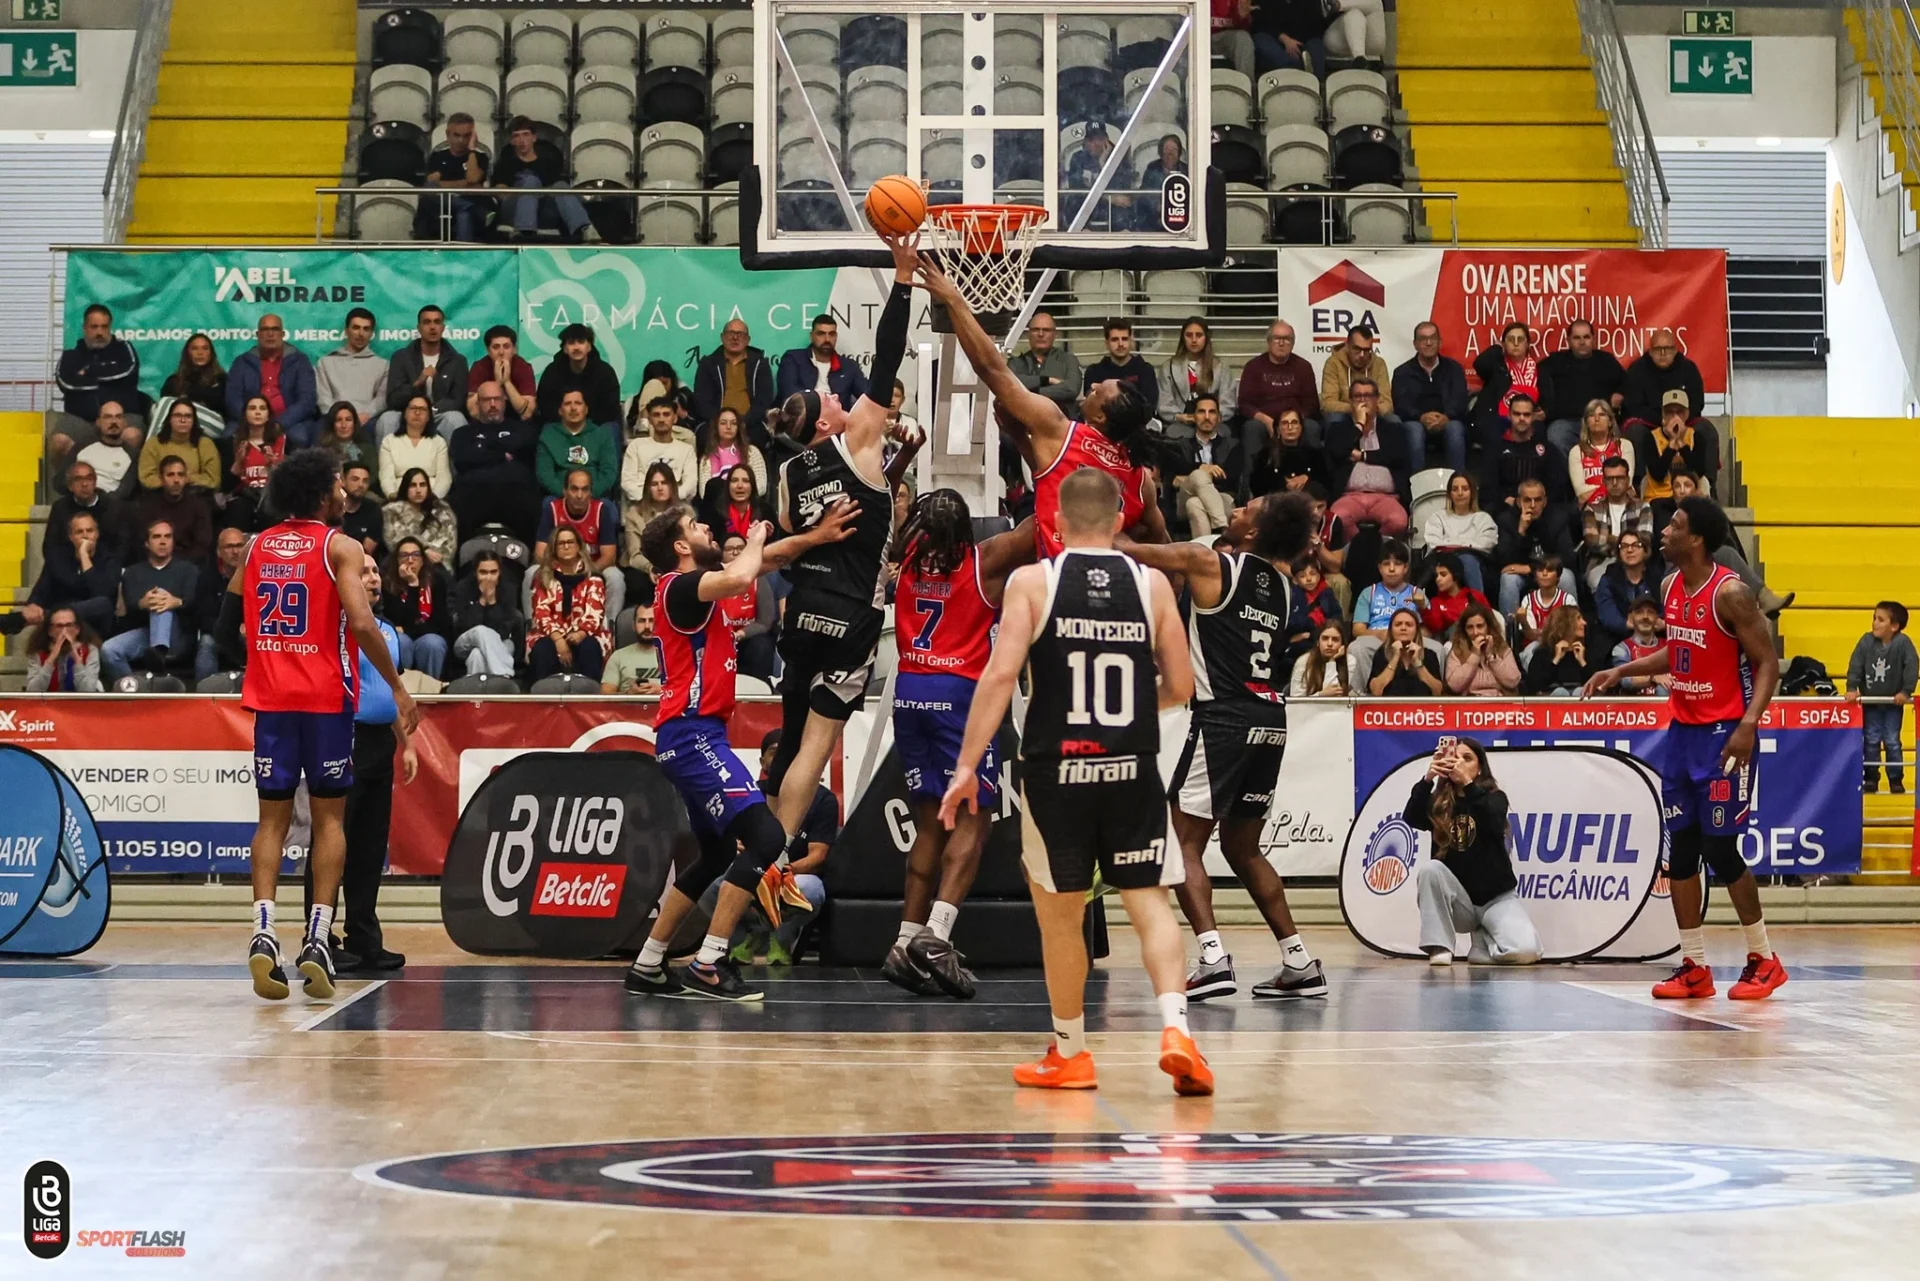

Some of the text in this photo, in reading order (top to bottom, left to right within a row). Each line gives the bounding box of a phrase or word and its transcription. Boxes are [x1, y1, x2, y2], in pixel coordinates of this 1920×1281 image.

[215, 266, 296, 302] ABEL
[1462, 263, 1587, 294] OVARENSE
[232, 286, 365, 302] ANDRADE
[526, 297, 932, 331] FARMÁCIA CENTA
[1312, 309, 1380, 334] ERA
[1465, 294, 1637, 326] UMA MÁQUINA
[112, 328, 192, 341] ARCAMOS
[379, 327, 480, 341] IMOBÁRIO
[1465, 328, 1480, 358] A
[263, 537, 314, 551] CACAROLA
[256, 581, 309, 637] 29
[796, 611, 849, 639] fibran
[911, 597, 944, 652] 7
[1056, 617, 1146, 643] MONTEIRO
[283, 641, 318, 656] Grupo
[928, 654, 965, 668] Grupo
[1249, 629, 1272, 680] 2
[1674, 646, 1691, 674] 18
[1066, 651, 1134, 728] 10
[19, 719, 55, 734] Spirit
[1363, 707, 1851, 726] COLCHÕES TOPPERS ALMOFADAS SOFÁS
[72, 768, 149, 783] VENDER
[152, 768, 168, 783] O
[173, 768, 209, 783] SEU
[1058, 754, 1139, 785] fibran
[86, 794, 166, 813] OMIGO!
[1709, 779, 1731, 802] 18
[116, 841, 157, 857] 105
[161, 841, 203, 857] 190
[1504, 812, 1639, 864] NUFIL
[1367, 857, 1405, 892] ASNUFIL
[1517, 869, 1631, 901] MECÂNICA
[538, 872, 616, 907] Betclic
